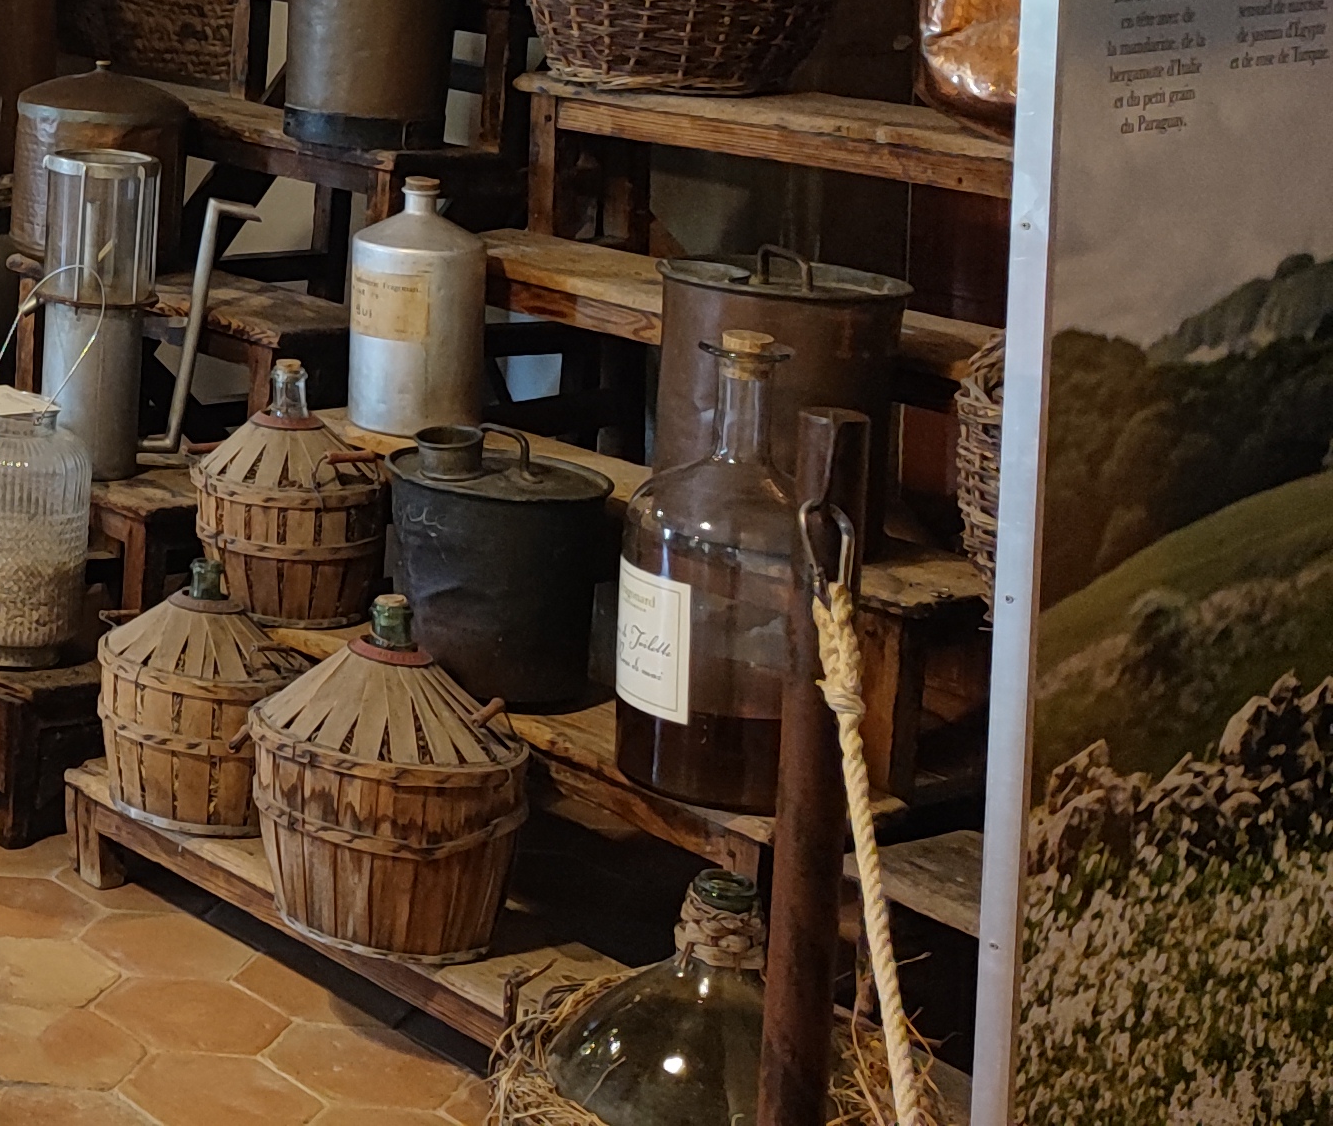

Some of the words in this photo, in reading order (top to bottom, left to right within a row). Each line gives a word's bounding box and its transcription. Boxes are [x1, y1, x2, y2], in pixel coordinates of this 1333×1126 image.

[1182, 6, 1196, 24] de
[1106, 40, 1118, 56] la
[1181, 32, 1194, 49] de
[1196, 29, 1207, 48] la
[1236, 27, 1249, 43] de
[1230, 57, 1240, 70] et
[1241, 52, 1254, 68] de
[1277, 48, 1290, 64] de
[1291, 45, 1330, 66] Turquie.
[1109, 65, 1164, 86] bergamote
[1166, 57, 1202, 76] d'Italie
[1114, 96, 1124, 109] et
[1126, 90, 1140, 107] du
[1142, 87, 1165, 111] petit
[1169, 84, 1196, 107] grain
[1120, 117, 1134, 134] du
[1138, 115, 1187, 134] Paraguay.
